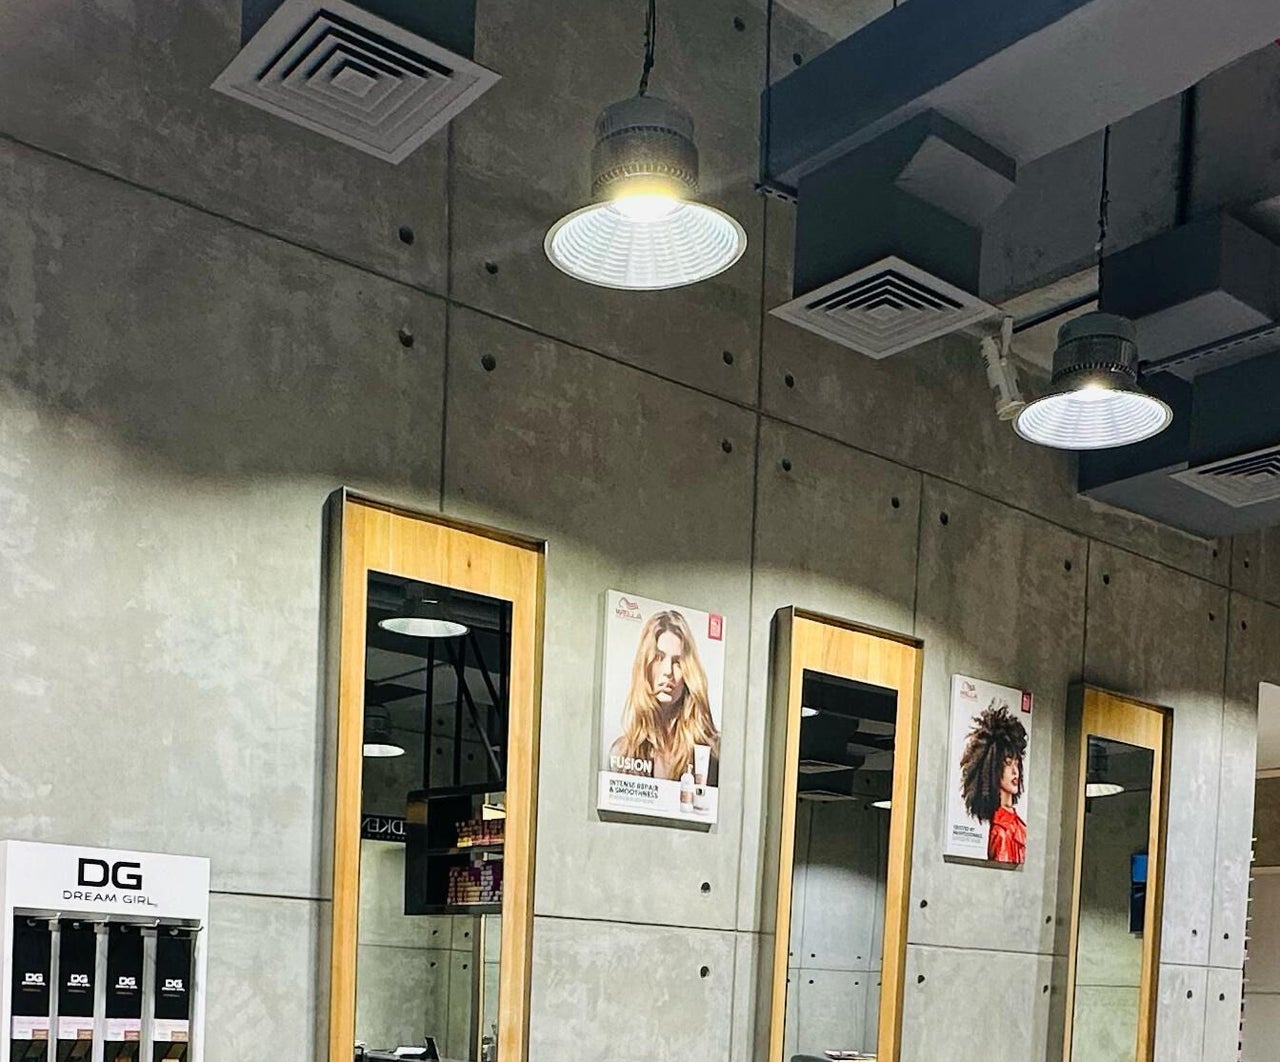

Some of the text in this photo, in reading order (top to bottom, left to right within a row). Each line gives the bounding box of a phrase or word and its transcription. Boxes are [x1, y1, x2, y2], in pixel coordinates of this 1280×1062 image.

[610, 756, 653, 774] FUSION
[609, 779, 659, 792] INTENSE REPAIR
[615, 786, 659, 799] SMOOTHNESS
[78, 858, 143, 890] DG
[62, 890, 156, 906] DREAM GIRL
[25, 972, 43, 982] DG
[70, 973, 89, 983] DG
[118, 976, 136, 986] DG
[165, 978, 183, 988] DG
